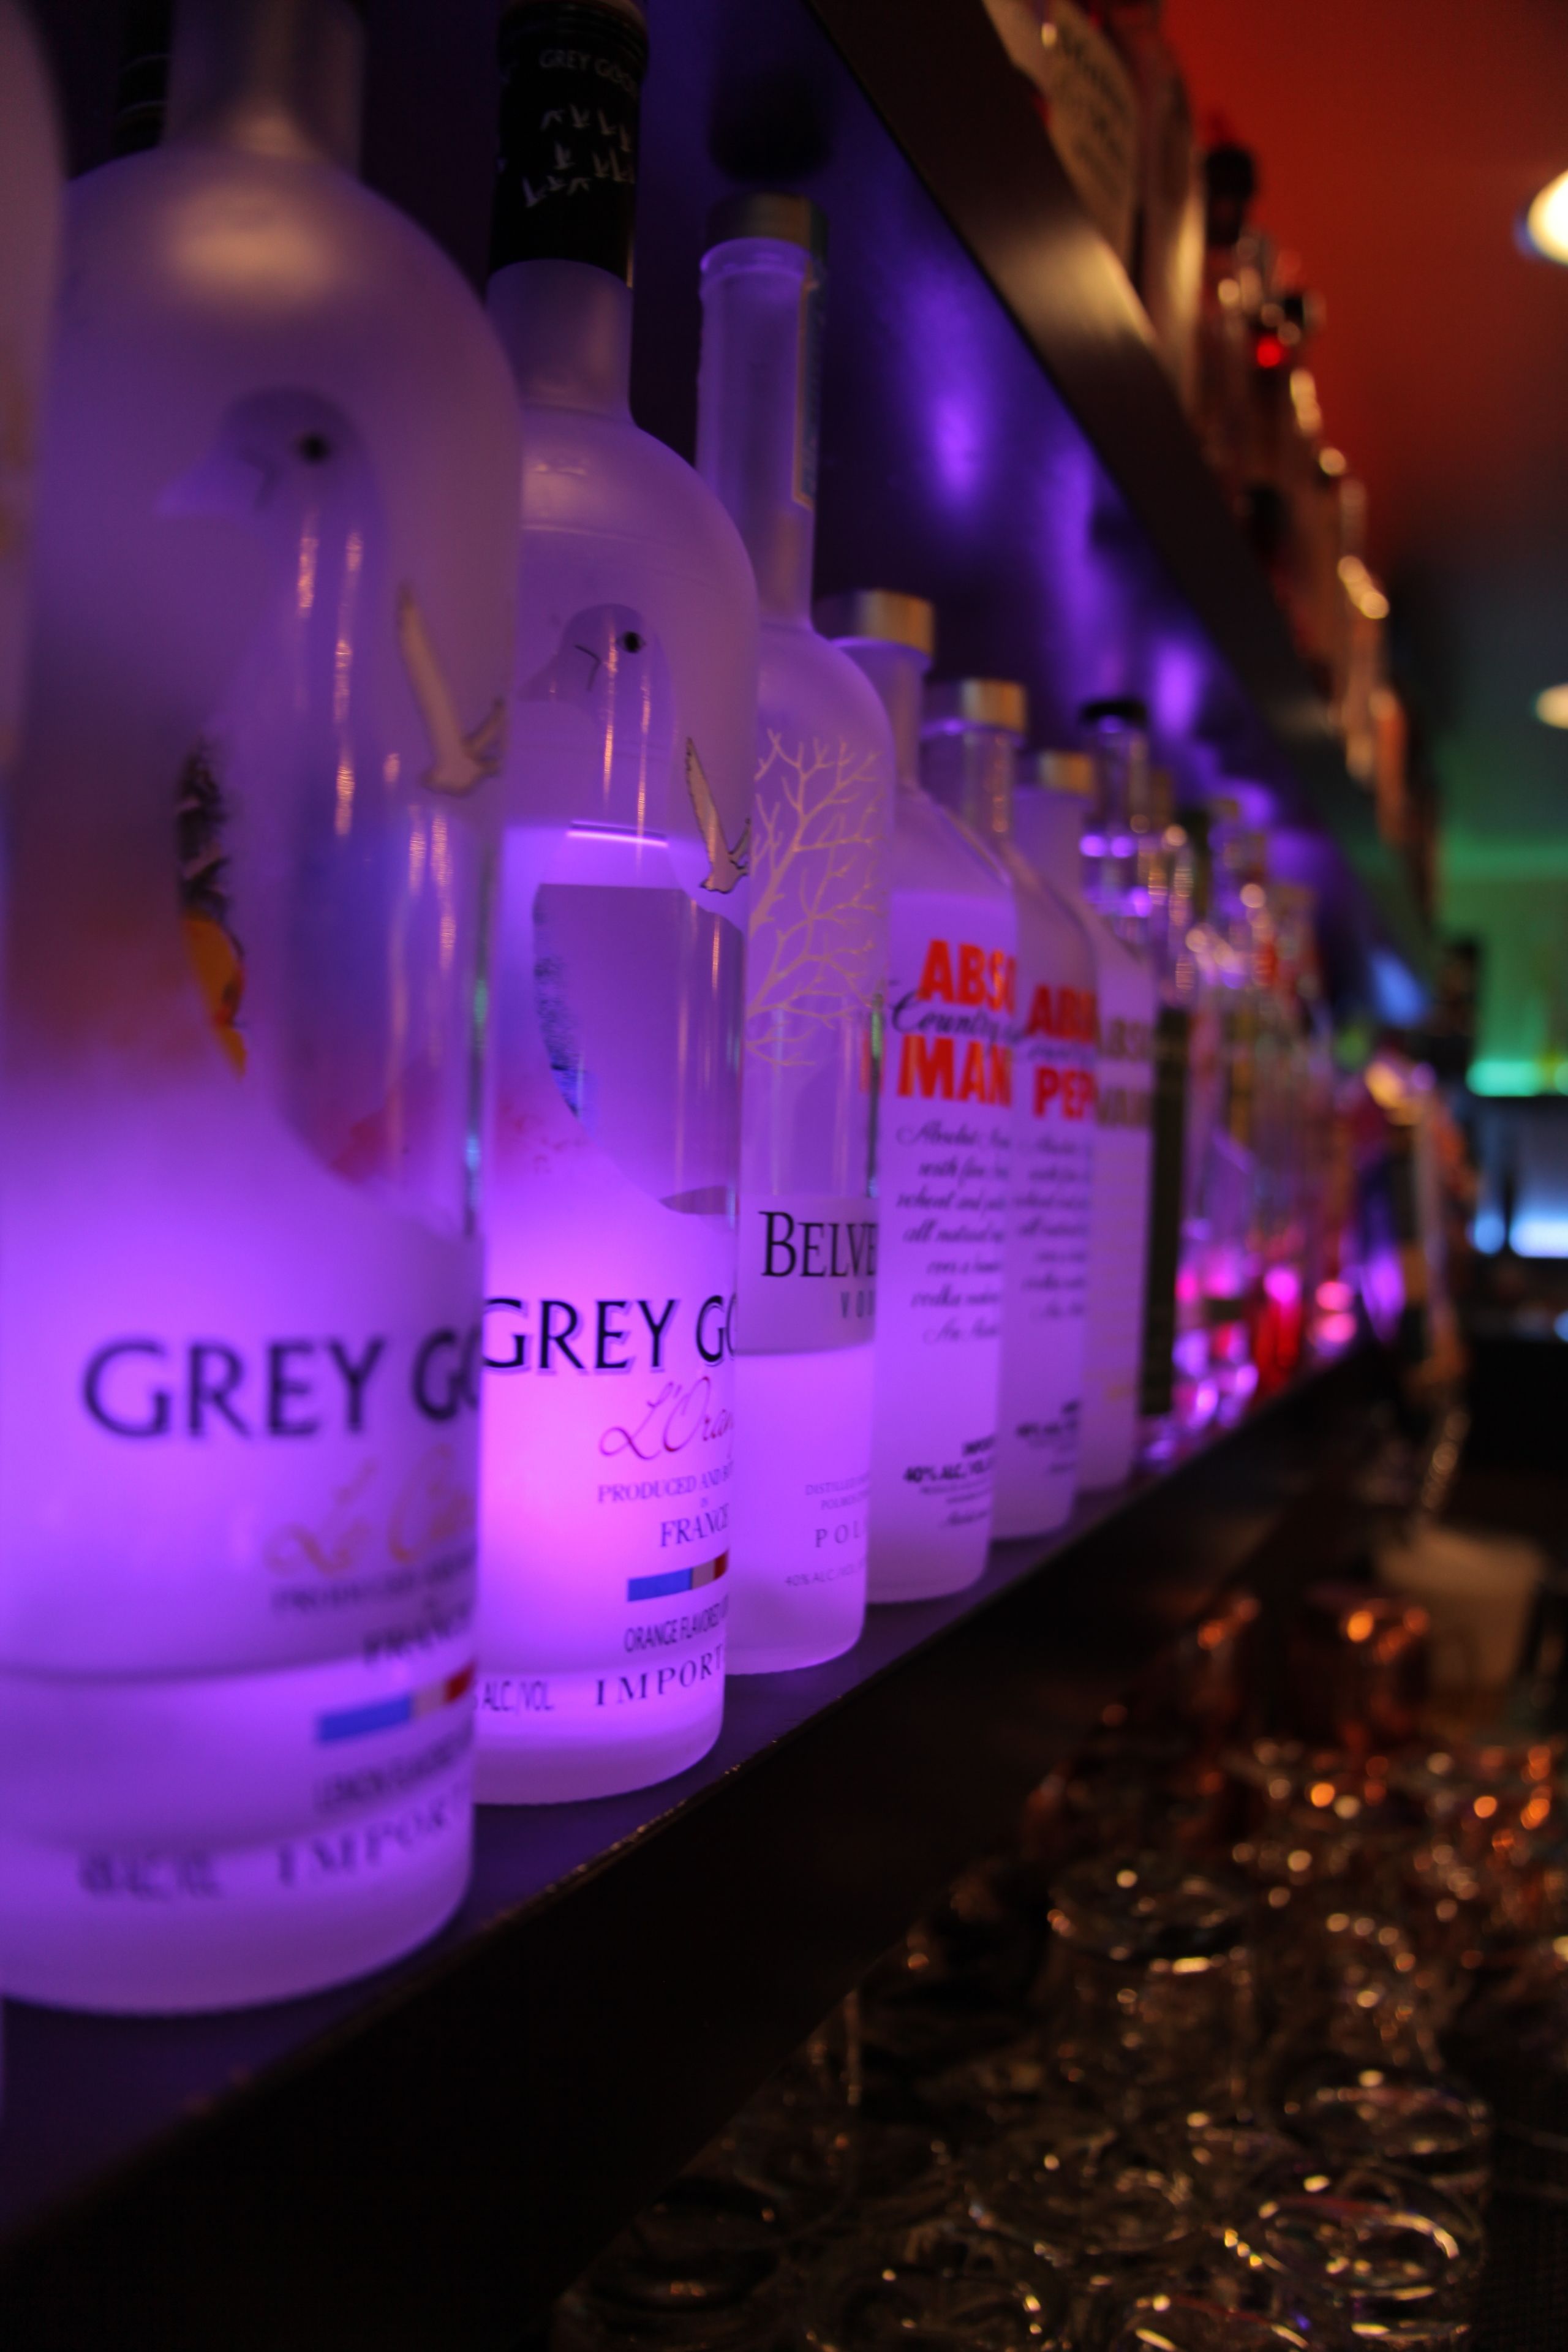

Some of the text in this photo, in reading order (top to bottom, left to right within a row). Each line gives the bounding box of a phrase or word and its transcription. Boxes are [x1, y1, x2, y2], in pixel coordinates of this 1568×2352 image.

[538, 48, 592, 71] GREY
[481, 1296, 681, 1377] GREY
[83, 1336, 386, 1441] GREY
[597, 1475, 697, 1504] PRODUCED
